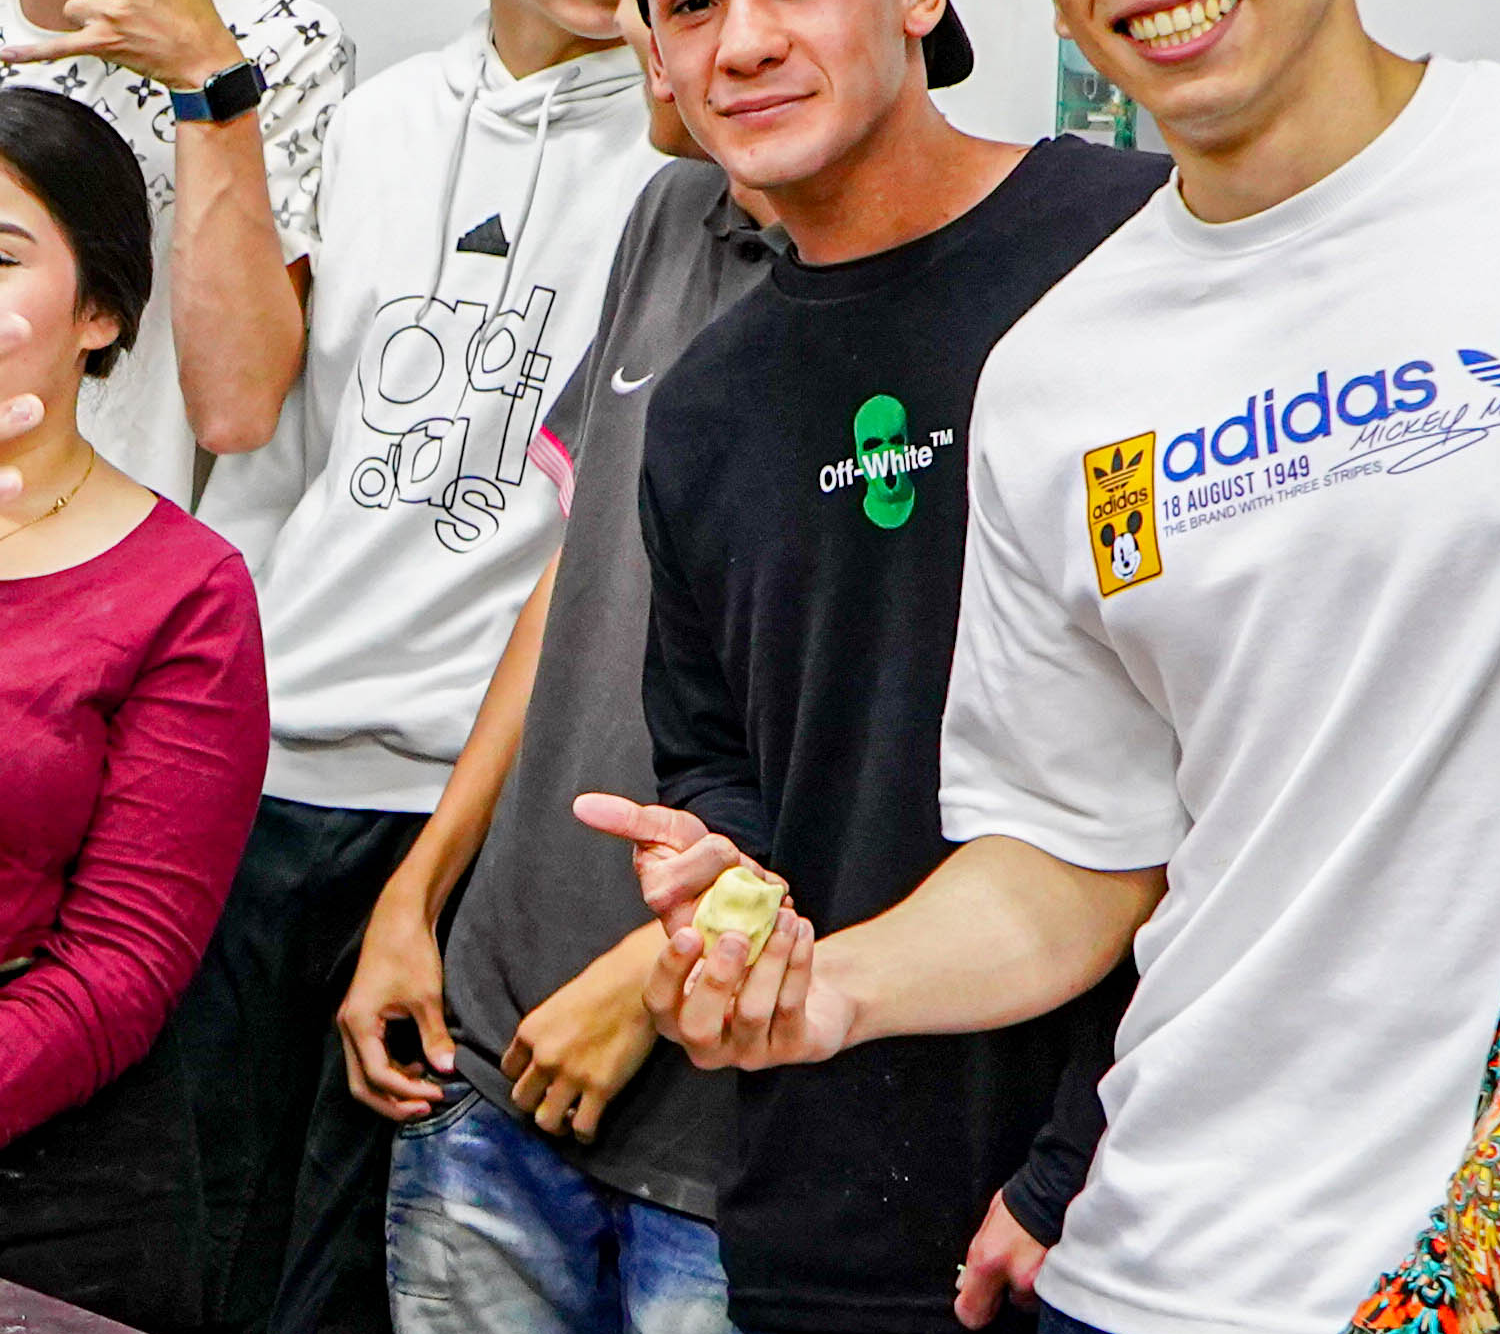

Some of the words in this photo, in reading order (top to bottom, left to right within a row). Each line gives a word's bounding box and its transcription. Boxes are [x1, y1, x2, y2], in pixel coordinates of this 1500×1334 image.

[1163, 359, 1437, 482] adidas
[1350, 403, 1469, 450] MICKEY
[1092, 487, 1149, 520] adidas
[1162, 495, 1181, 521] 18
[1187, 472, 1254, 513] AUGUST
[1264, 454, 1310, 489] 1949
[1163, 520, 1188, 539] THE
[1190, 504, 1236, 530] BRAND
[1239, 494, 1274, 515] WITH
[1277, 478, 1319, 503] THREE
[1323, 460, 1383, 488] STRIPES
